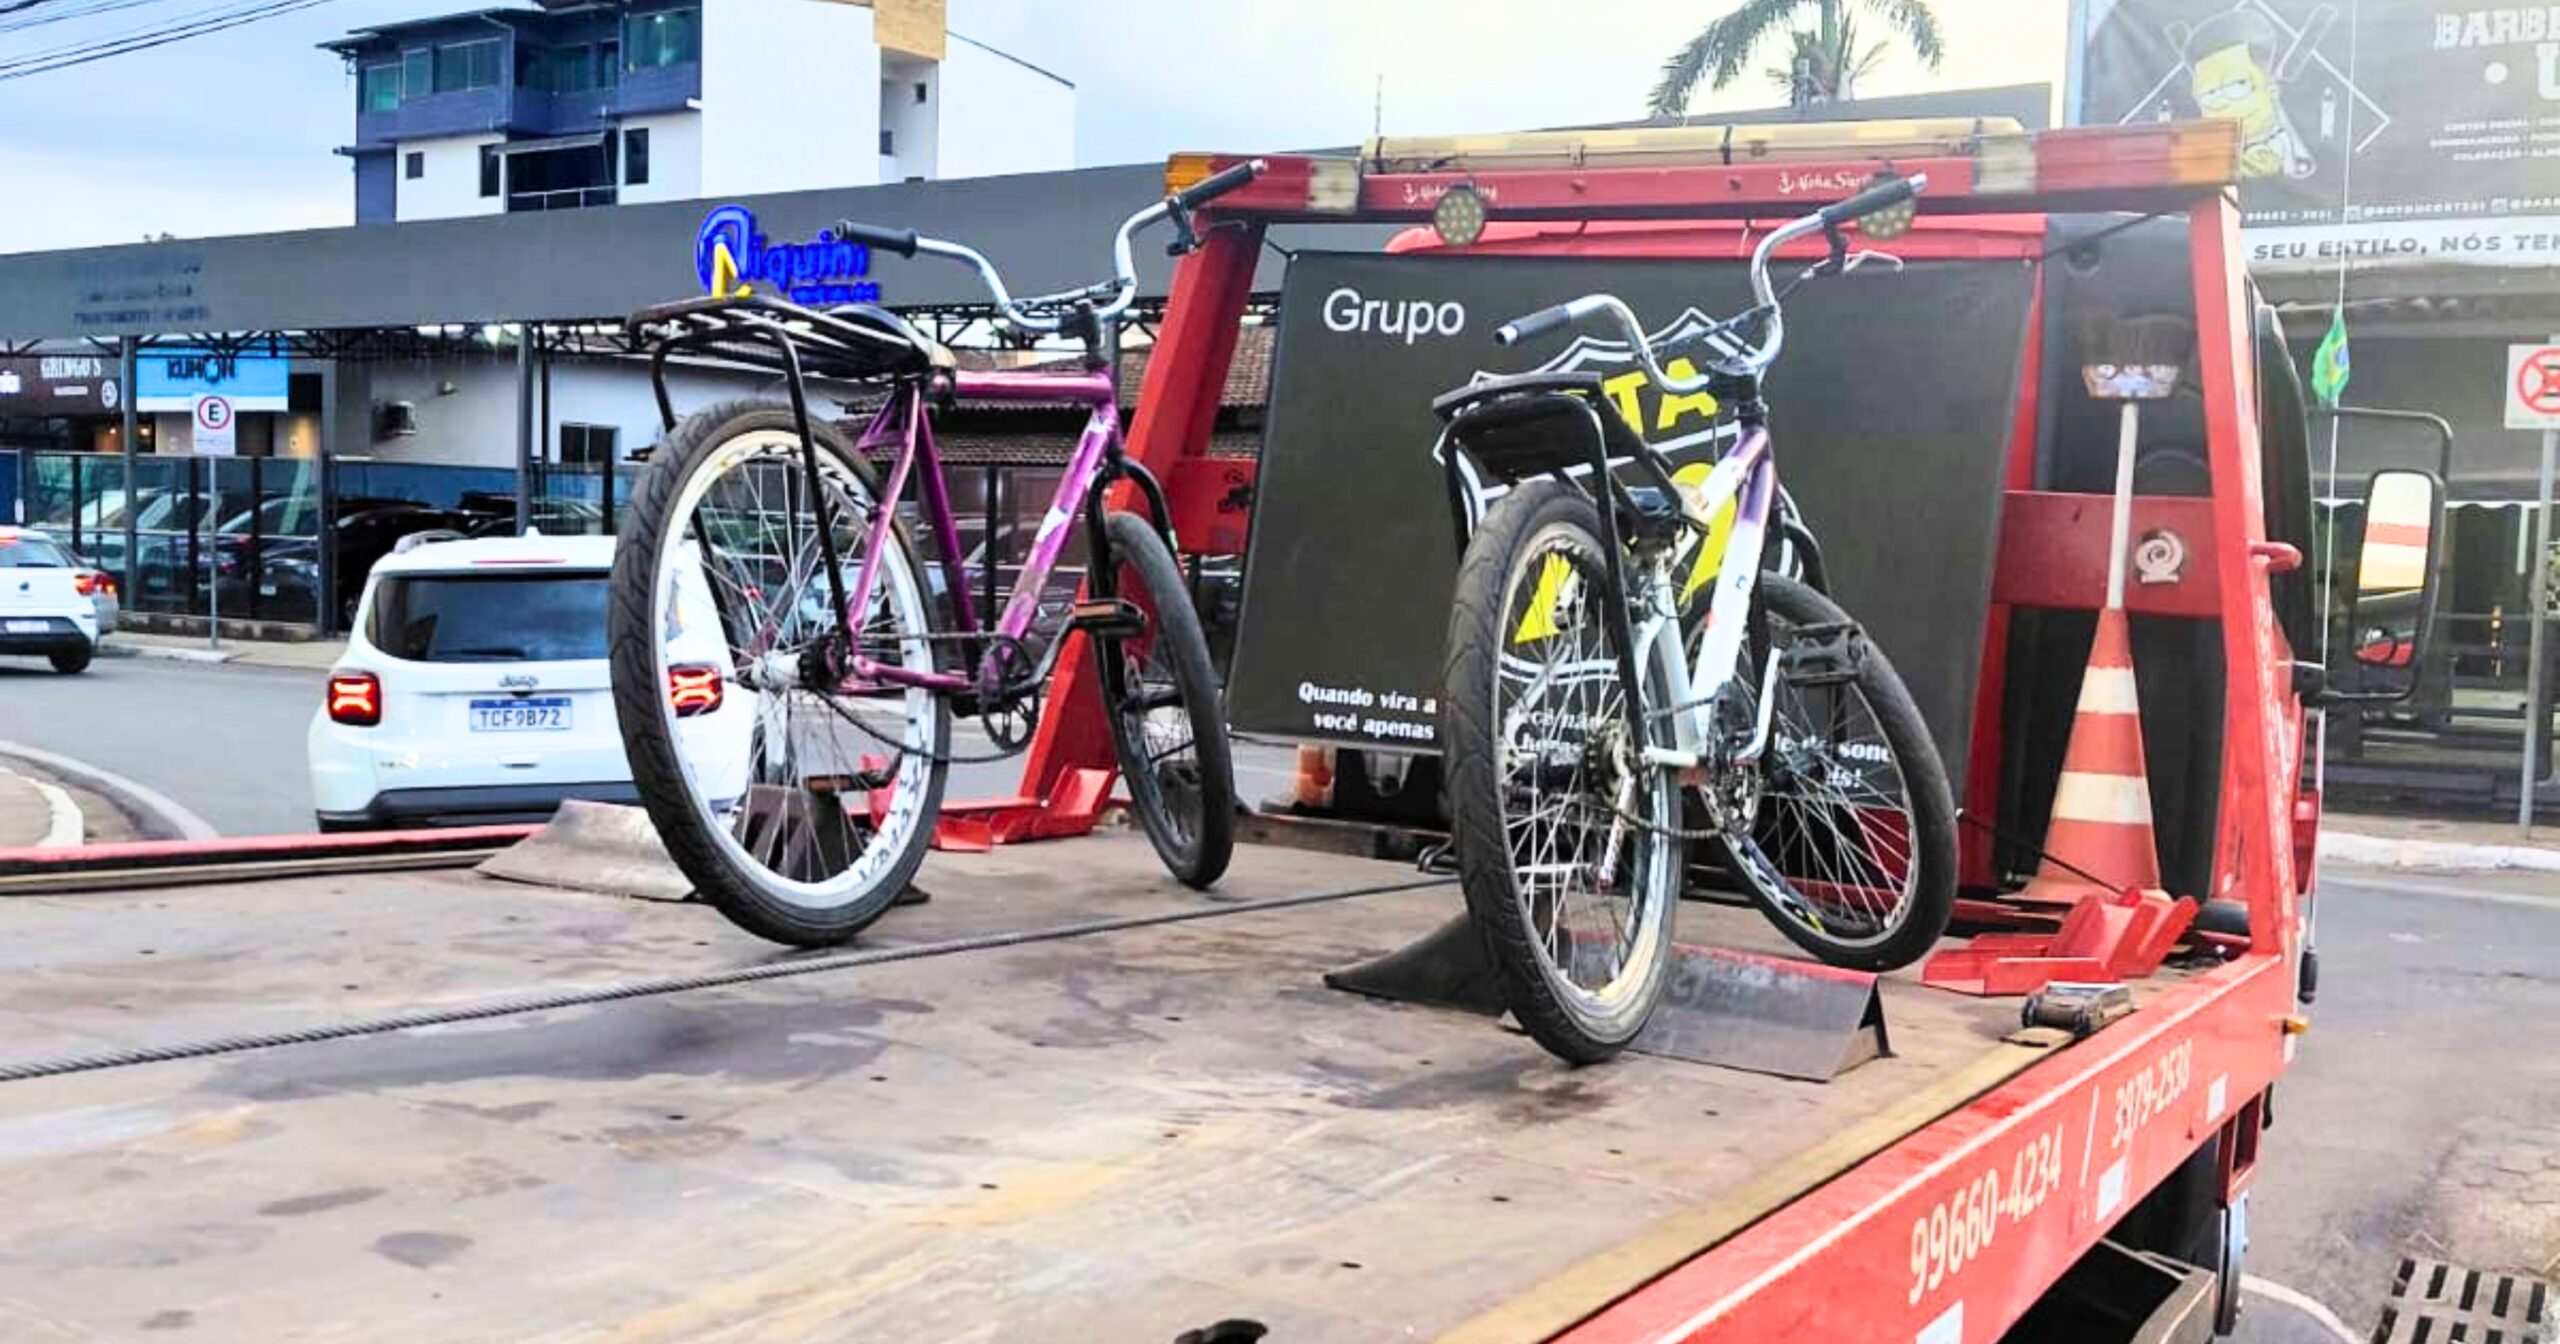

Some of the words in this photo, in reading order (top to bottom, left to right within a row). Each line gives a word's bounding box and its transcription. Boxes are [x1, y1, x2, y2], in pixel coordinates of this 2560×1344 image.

[2253, 242, 2308, 260] SEU
[2317, 237, 2427, 257] ESTILO,
[2440, 231, 2502, 253] NÓS
[1323, 287, 1466, 346] Grupo
[208, 404, 220, 422] E
[1299, 681, 1374, 707] Quando
[1379, 690, 1417, 712] vira
[1423, 698, 1437, 714] a
[480, 708, 561, 727] TCF9B72
[1314, 711, 1358, 732] você
[1362, 718, 1434, 739] apenas
[1910, 1124, 2062, 1304] 99660-4234
